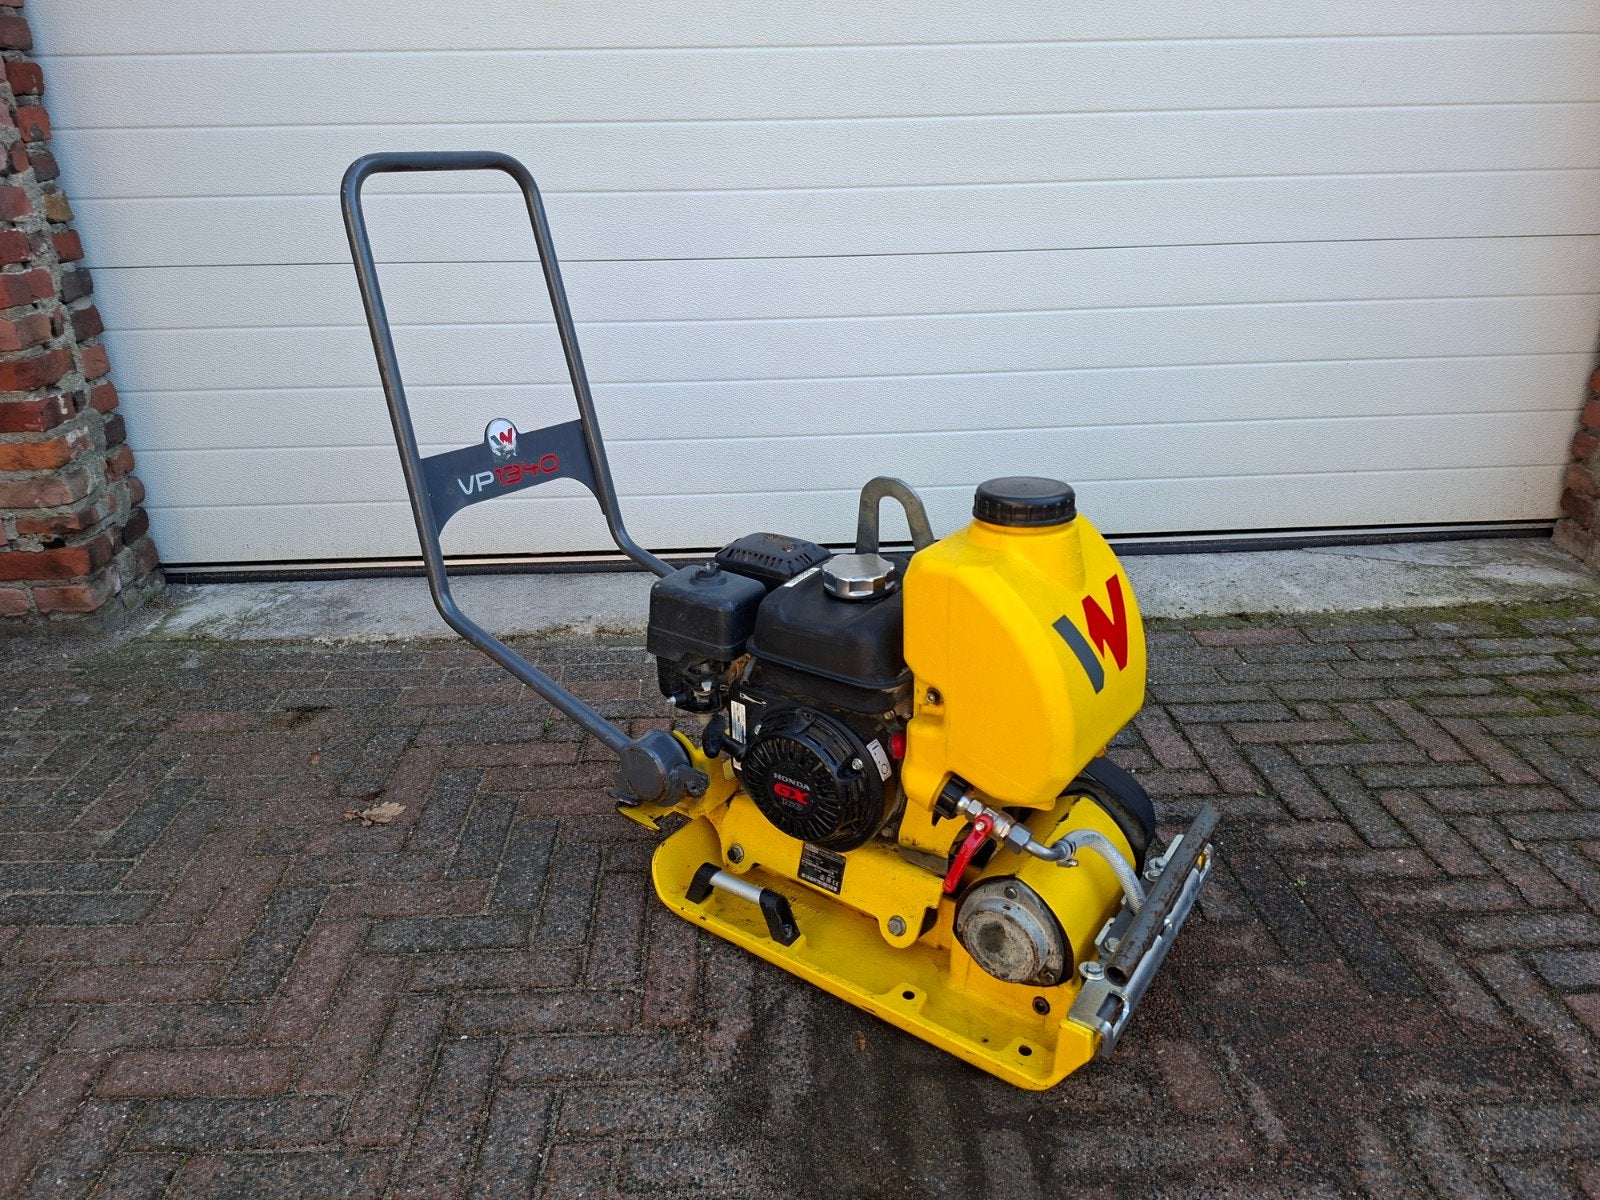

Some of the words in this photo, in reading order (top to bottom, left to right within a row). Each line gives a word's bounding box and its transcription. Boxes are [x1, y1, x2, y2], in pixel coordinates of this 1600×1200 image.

[457, 453, 559, 496] VP1340
[773, 772, 811, 792] HONDA
[774, 783, 811, 806] GX
